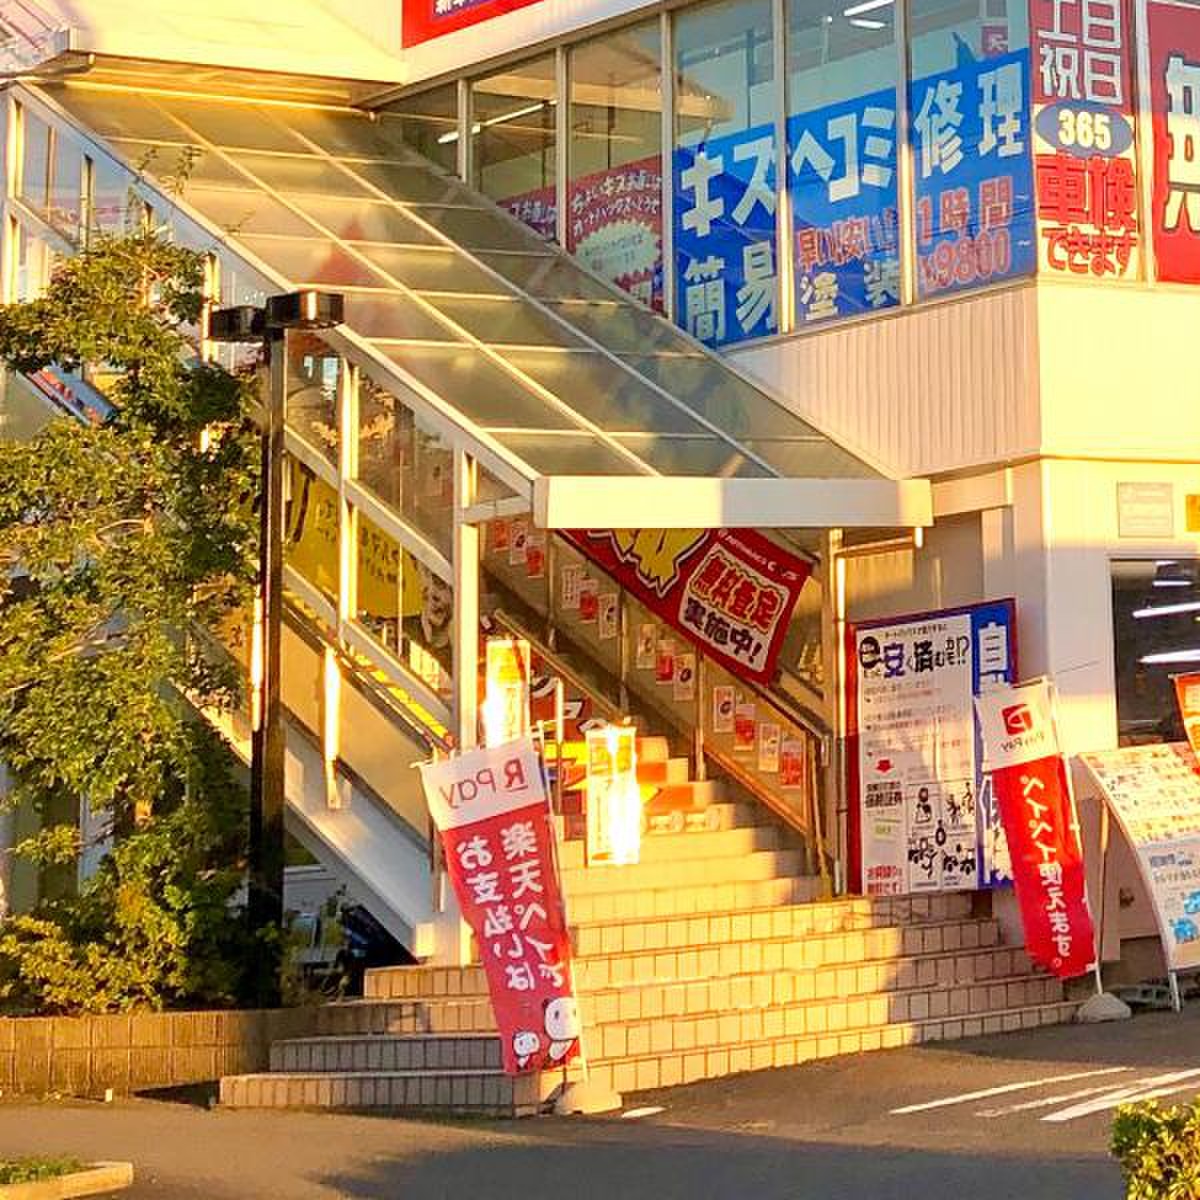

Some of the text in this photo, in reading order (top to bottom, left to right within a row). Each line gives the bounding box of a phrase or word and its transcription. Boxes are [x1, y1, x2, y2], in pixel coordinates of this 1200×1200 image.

[1040, 46, 1122, 104] 祝日
[1058, 110, 1112, 150] 365
[1036, 155, 1137, 232] 車検
[1041, 226, 1137, 277] できます
